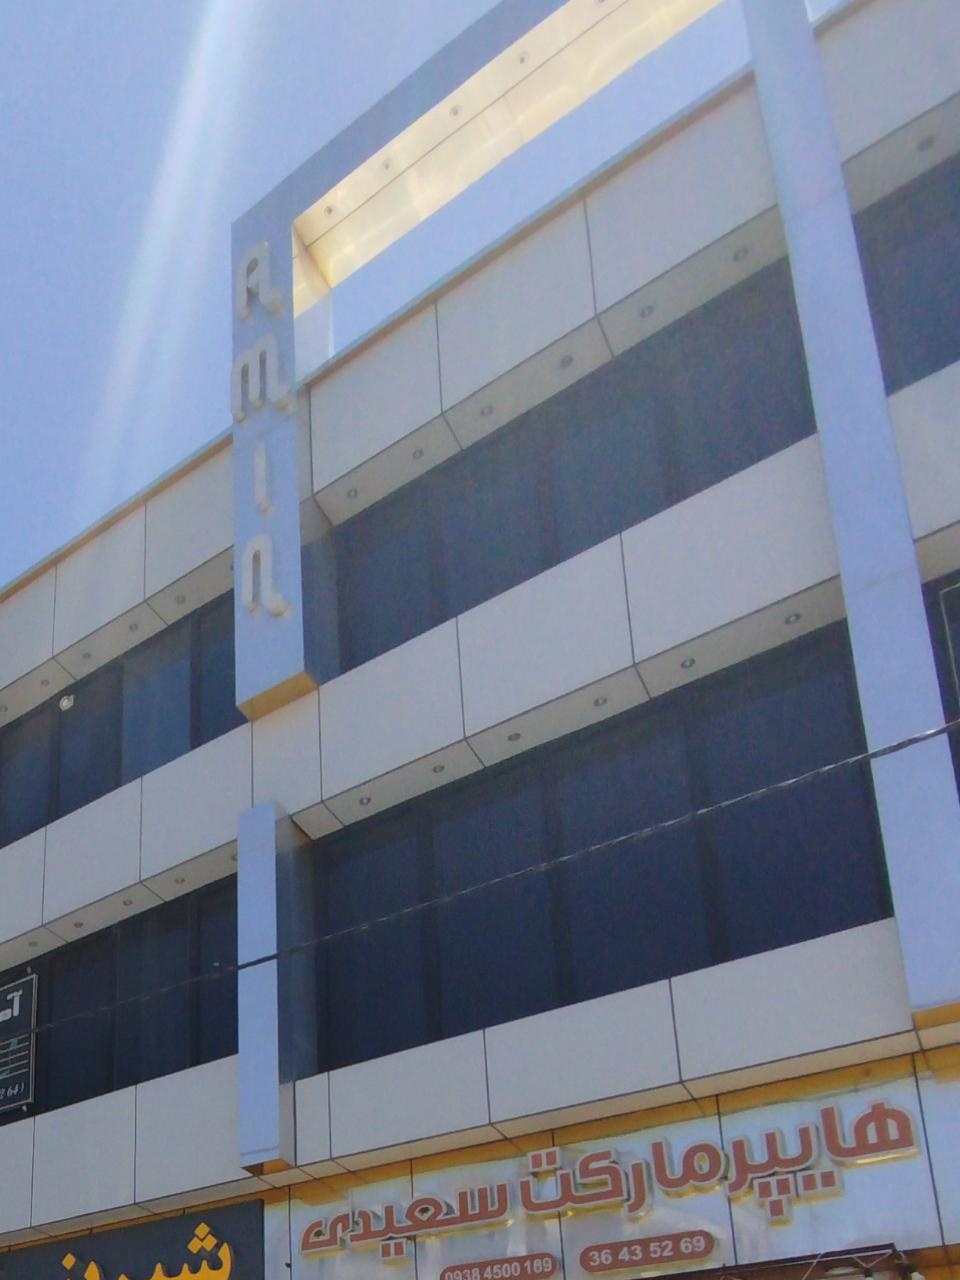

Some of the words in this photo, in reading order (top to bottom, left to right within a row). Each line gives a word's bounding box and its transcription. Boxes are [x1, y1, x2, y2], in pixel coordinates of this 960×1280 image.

[300, 1181, 509, 1259] سعیدی
[588, 1248, 613, 1266] 36
[617, 1244, 643, 1262] 43
[649, 1240, 673, 1258] 52
[679, 1235, 706, 1254] 69
[482, 1261, 521, 1280] 4500
[524, 1256, 553, 1276] 169
